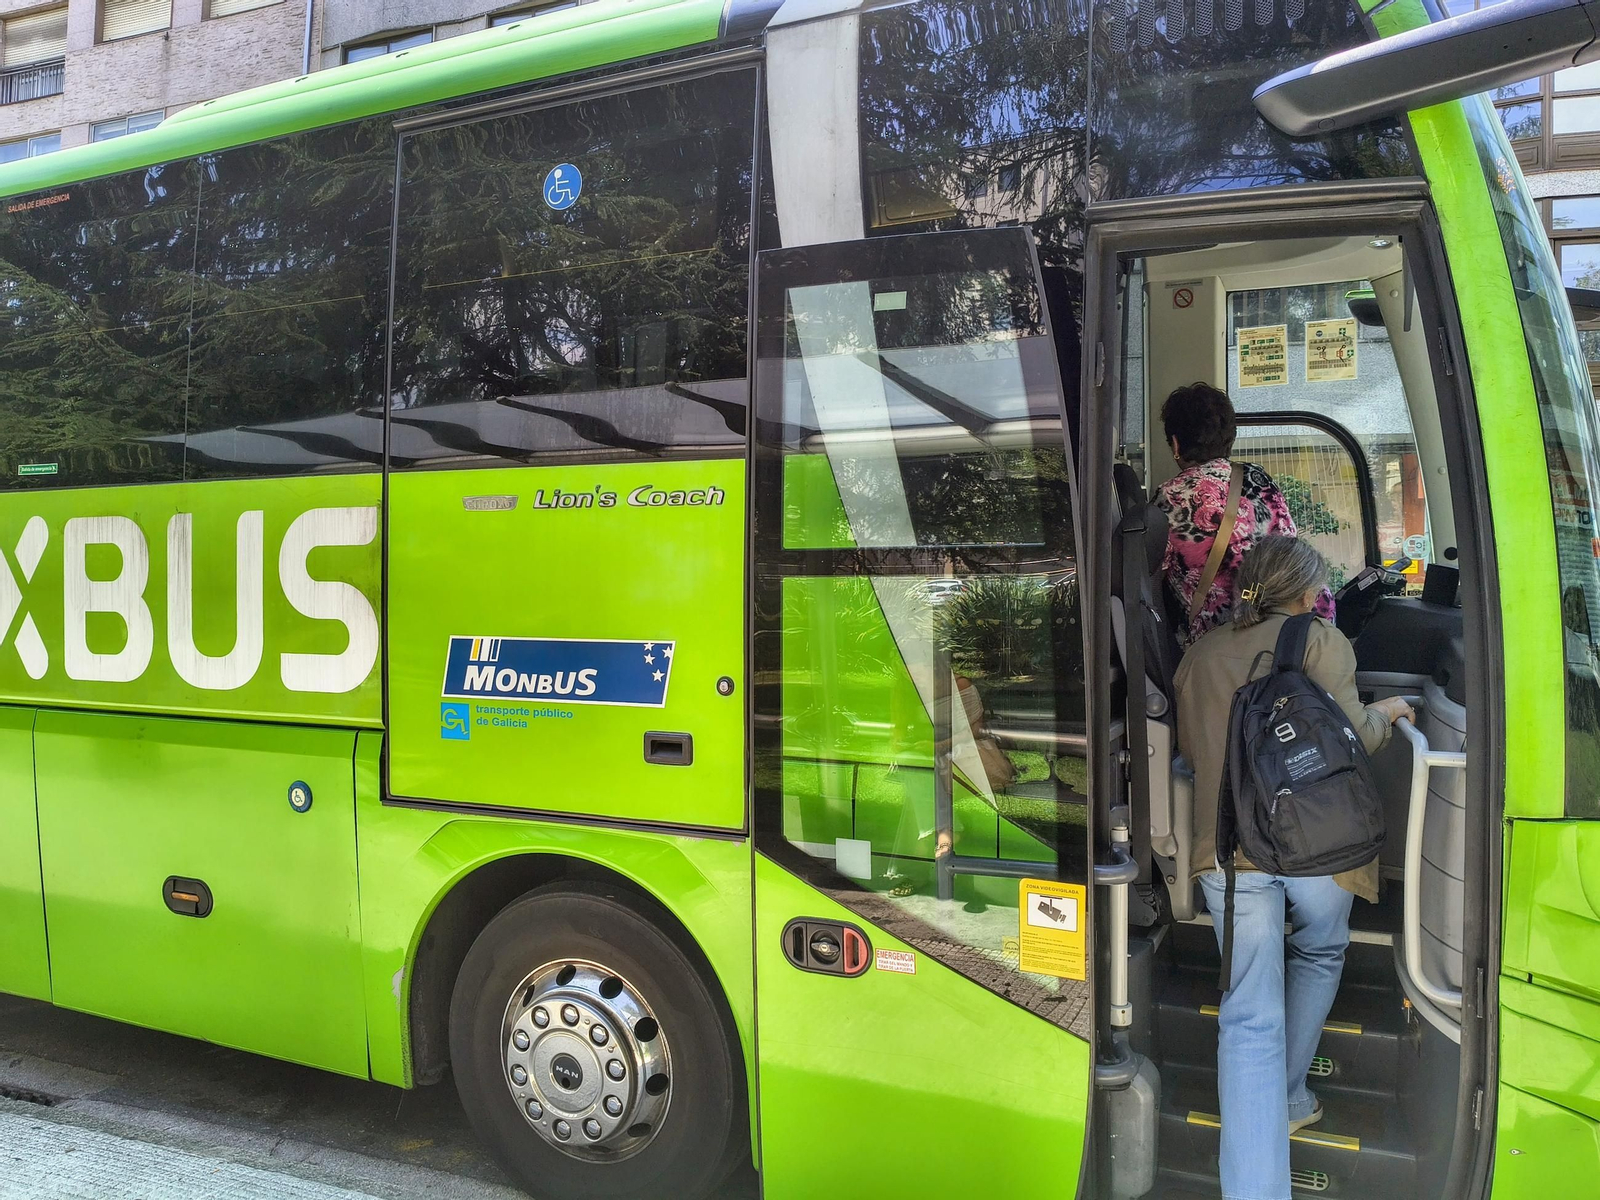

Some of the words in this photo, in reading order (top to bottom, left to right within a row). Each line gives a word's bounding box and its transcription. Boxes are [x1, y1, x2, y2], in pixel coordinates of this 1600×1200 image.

[8, 203, 27, 213] SALIDA
[27, 200, 35, 209] DE
[35, 193, 70, 207] EMERGENCIA
[533, 485, 617, 509] Lion's
[627, 485, 725, 507] Coach
[476, 704, 530, 717] transporte
[533, 707, 574, 719] público
[476, 717, 489, 726] de
[491, 717, 528, 728] Galicia
[1040, 885, 1079, 894] VIDEOVIGILADA
[877, 950, 914, 962] EMERGENCIA
[555, 1065, 579, 1079] MAN
